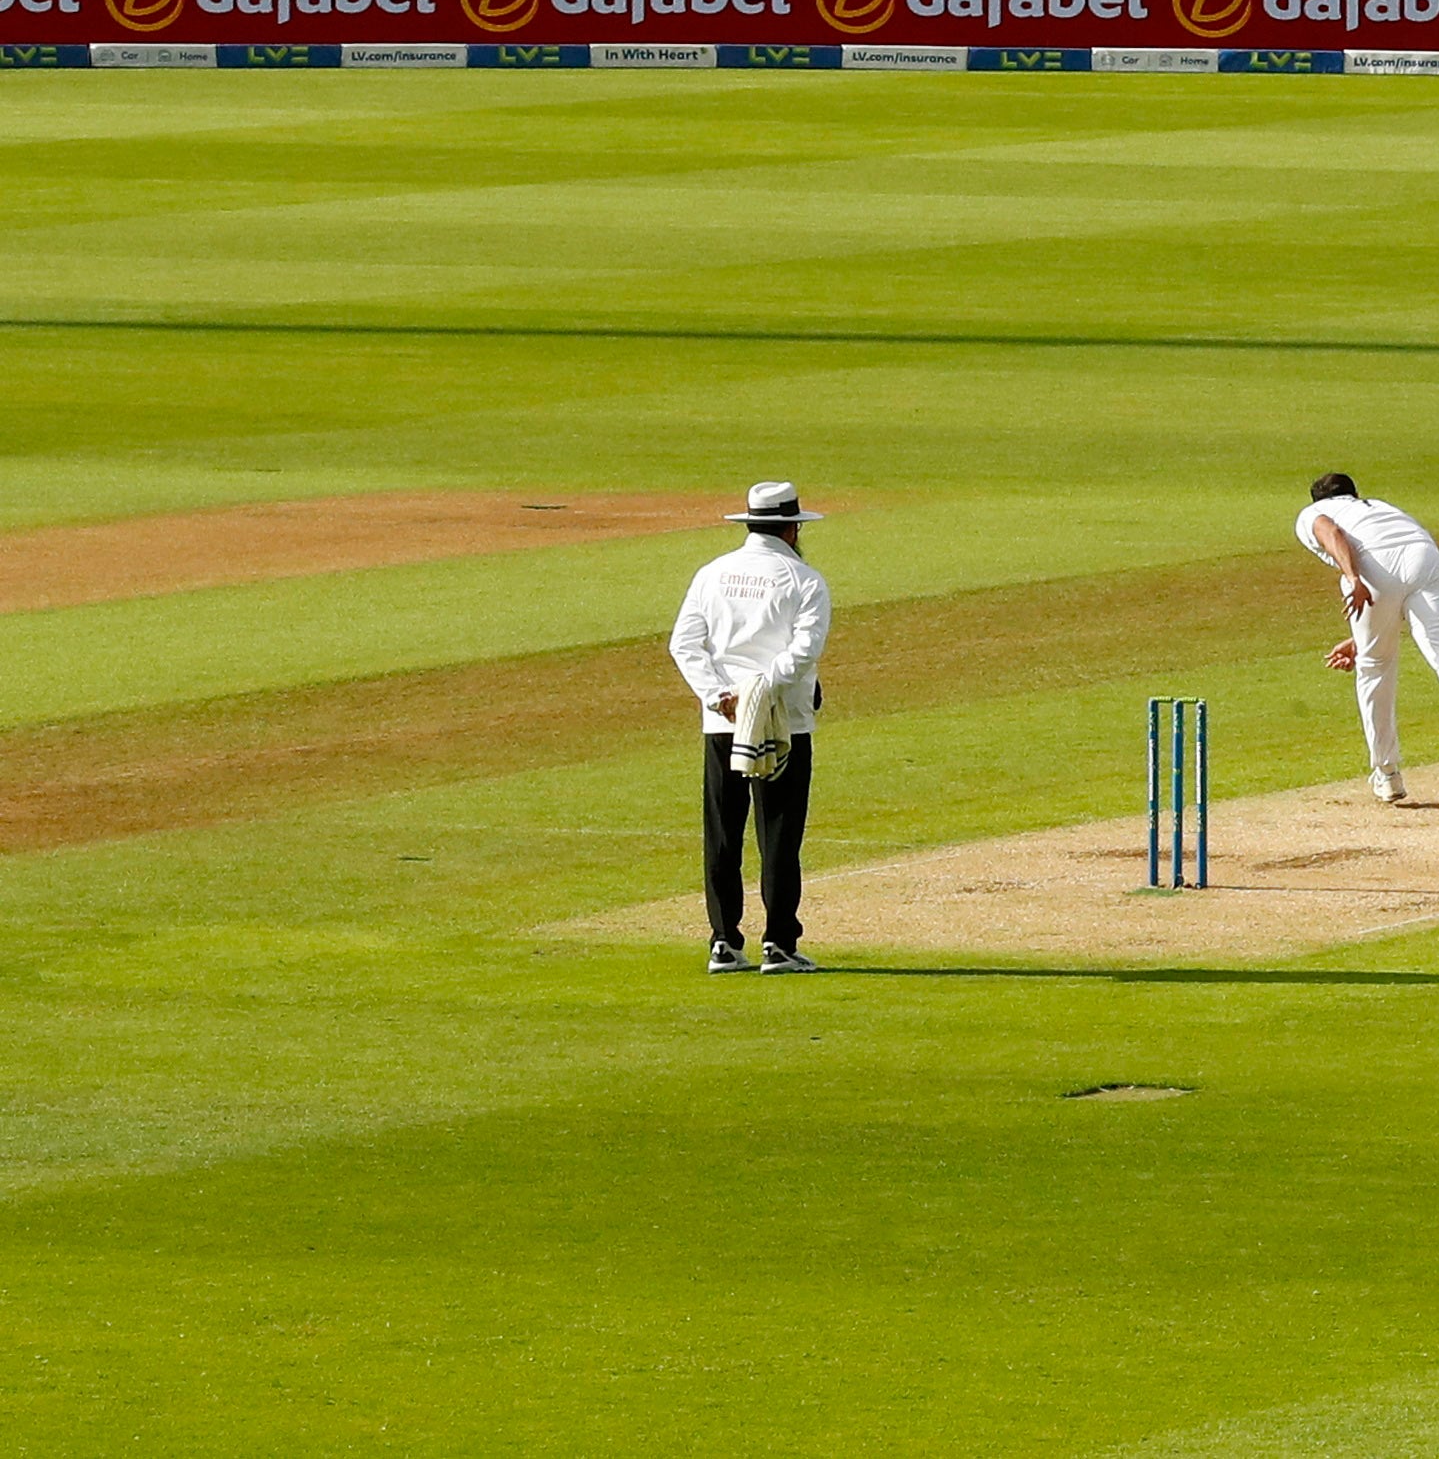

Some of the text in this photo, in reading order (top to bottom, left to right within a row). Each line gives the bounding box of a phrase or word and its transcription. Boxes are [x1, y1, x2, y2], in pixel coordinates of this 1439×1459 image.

[120, 51, 207, 60] Car Home
[351, 51, 456, 62] LV.com/insurance
[604, 49, 697, 60] In With Heart
[852, 52, 956, 63] LV.com/insurance
[1121, 56, 1208, 65] Car Home
[718, 572, 778, 588] Emirates
